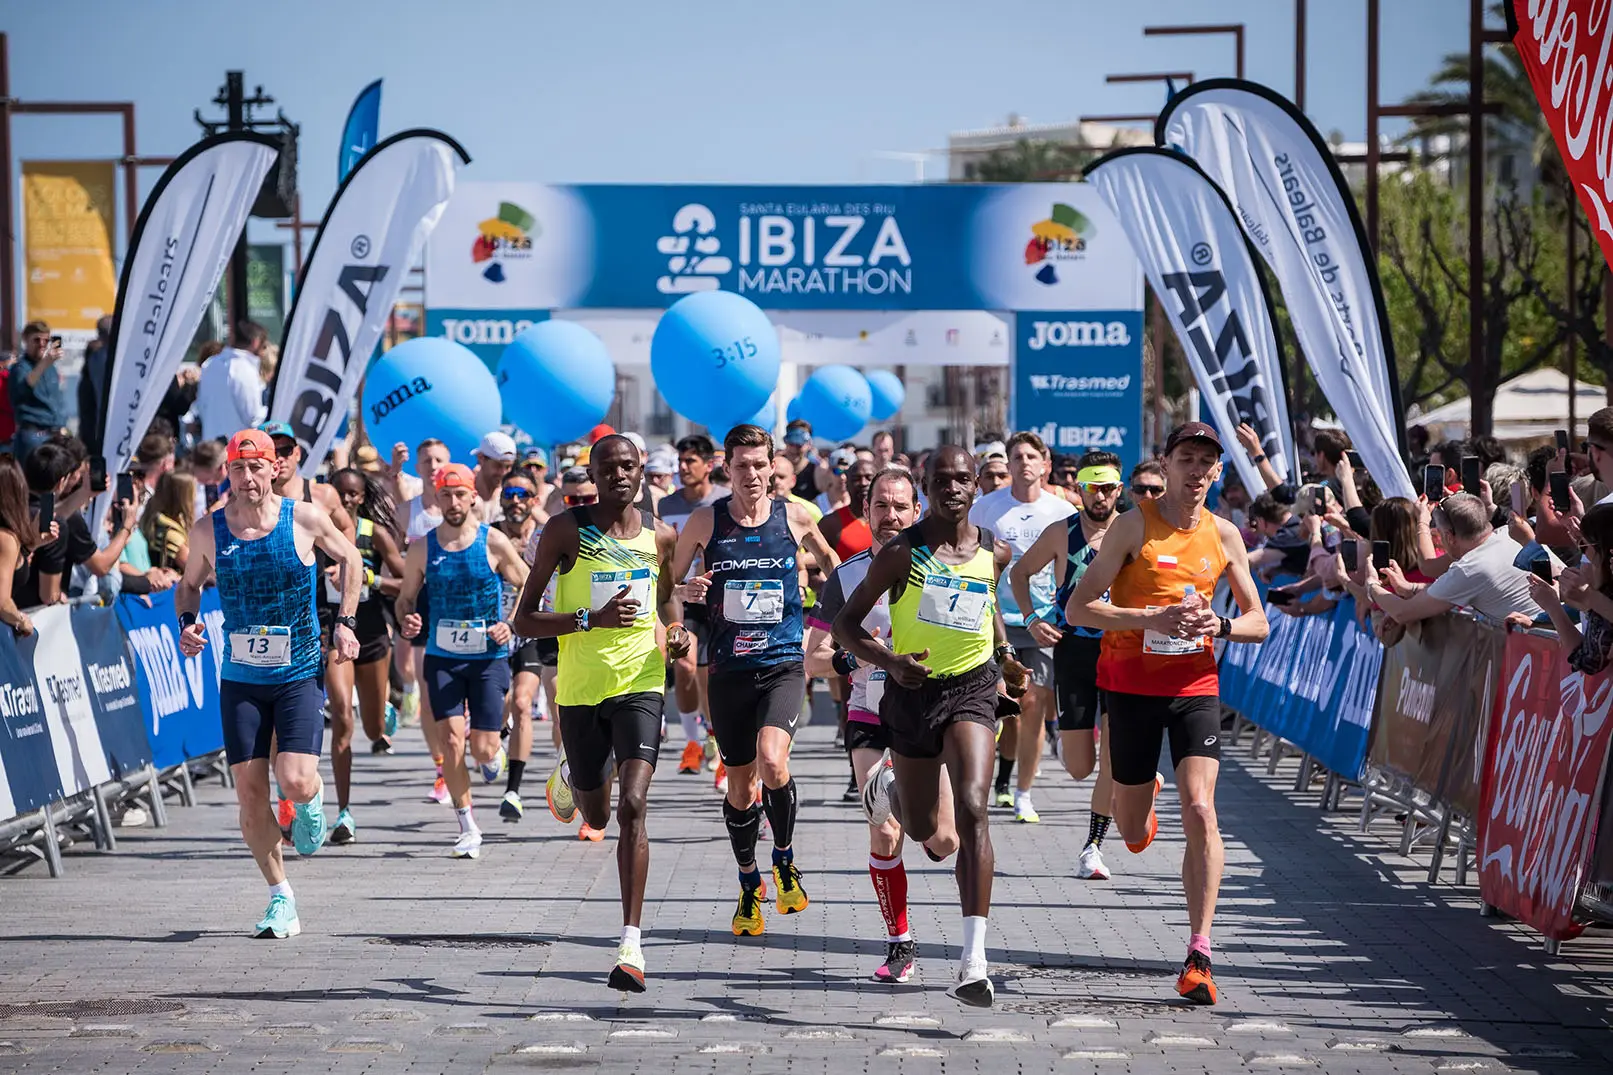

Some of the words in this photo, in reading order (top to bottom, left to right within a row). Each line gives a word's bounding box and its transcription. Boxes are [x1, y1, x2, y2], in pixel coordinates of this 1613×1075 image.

[739, 202, 785, 215] SANTA
[844, 202, 871, 215] DES
[873, 202, 896, 215] RIU
[738, 215, 912, 266] IBIZA
[738, 267, 913, 294] MARATHON
[711, 335, 758, 369] 3:15
[288, 264, 390, 470] BIZA
[1050, 373, 1131, 391] Trasmed
[1020, 529, 1041, 538] IBIZ
[712, 557, 784, 573] COMPEX
[746, 592, 758, 610] 7
[949, 593, 960, 612] 1
[247, 637, 269, 654] 13
[451, 630, 469, 644] 14
